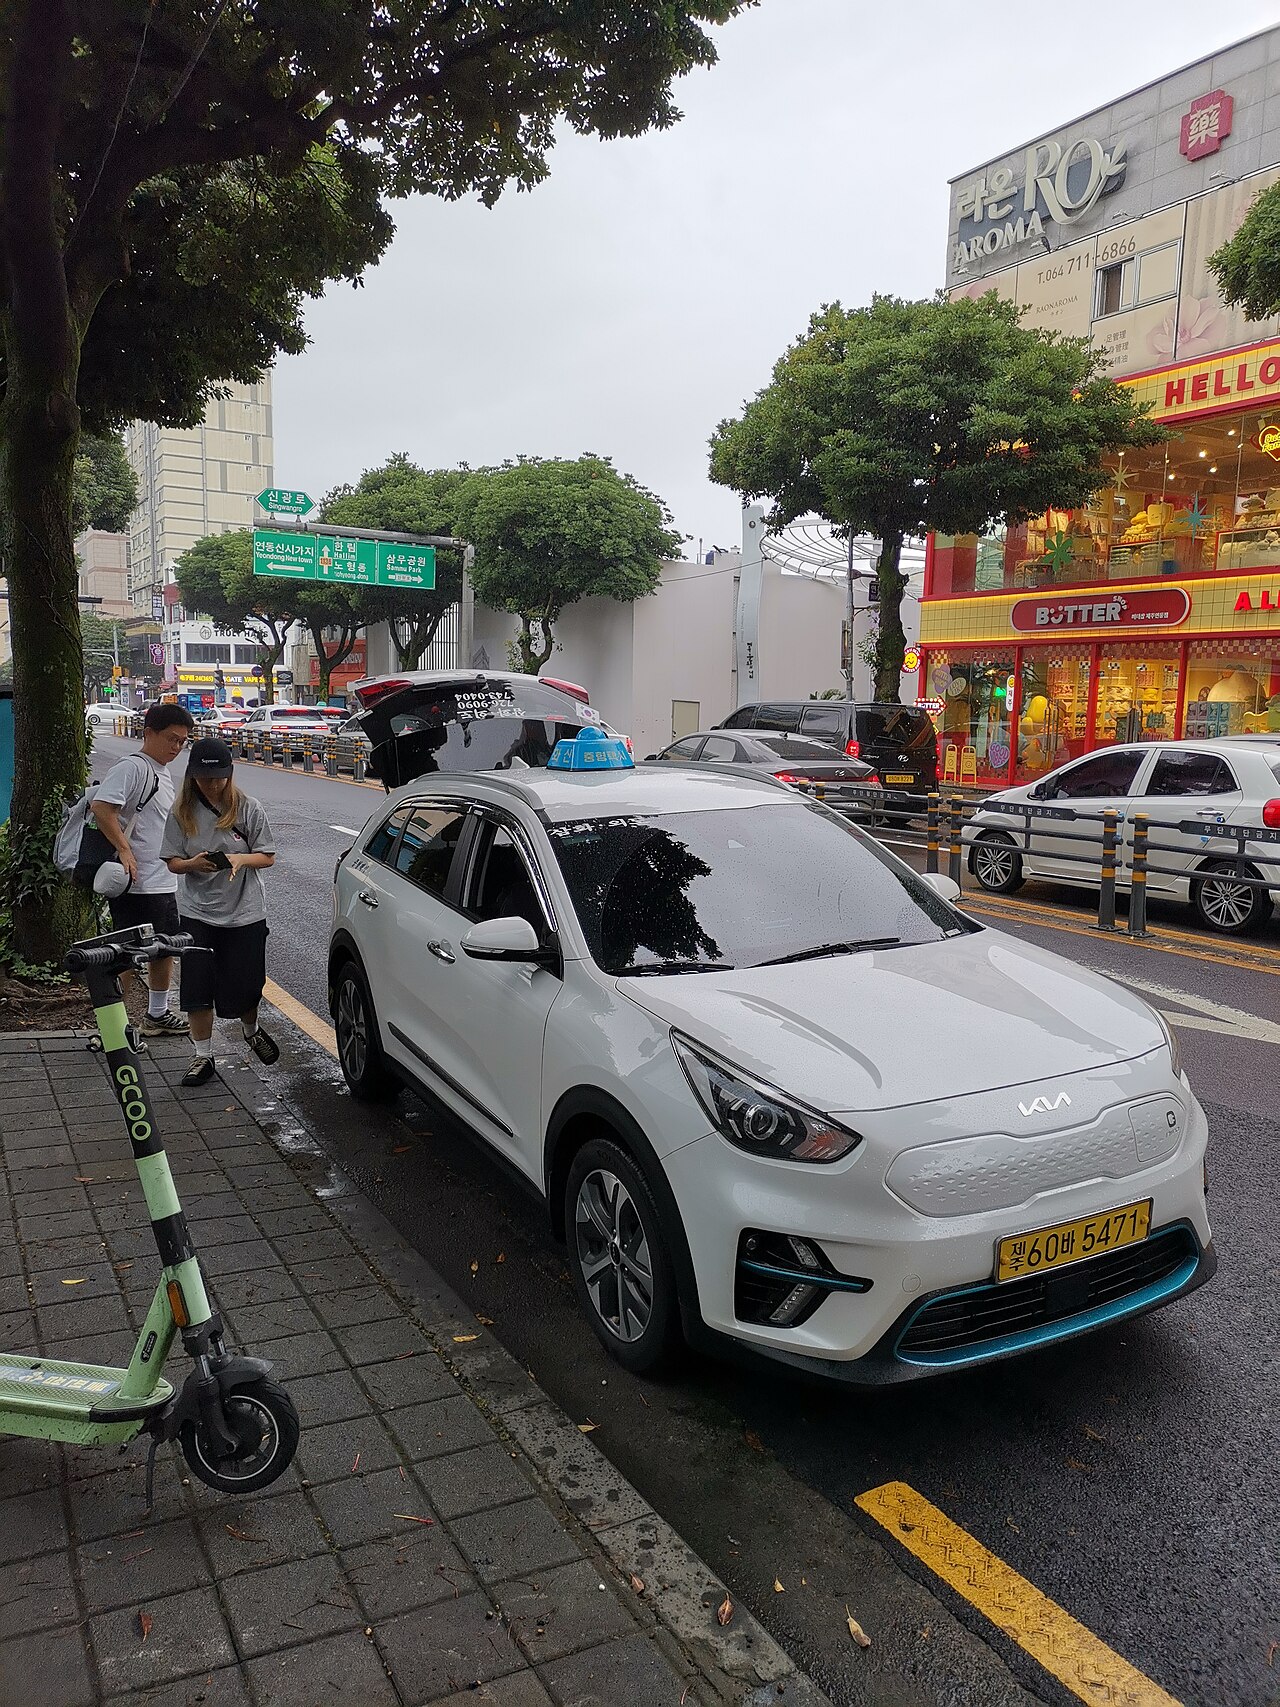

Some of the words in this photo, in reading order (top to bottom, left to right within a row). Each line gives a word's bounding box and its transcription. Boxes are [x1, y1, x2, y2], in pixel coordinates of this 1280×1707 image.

[1188, 101, 1221, 149] 藥
[956, 167, 1018, 223] 라온
[953, 210, 1046, 267] AROMA
[1037, 264, 1064, 284] T.064
[1067, 235, 1137, 275] 711-6866
[1165, 356, 1280, 408] HELLO
[267, 490, 306, 505] 신광로
[268, 503, 303, 513] Singwangro
[255, 541, 315, 557] 연동신시가지
[334, 541, 356, 553] 한림
[255, 552, 285, 562] Yeondong
[334, 552, 356, 560] Hallim
[387, 554, 426, 567] 삼우공원
[334, 561, 367, 573] 노형동
[387, 563, 408, 573] Sammu
[408, 565, 422, 574] Park
[1112, 595, 1128, 610] SHOP
[1234, 590, 1280, 612] AL
[244, 630, 268, 638] HAS
[116, 1065, 152, 1140] GCOO
[1082, 1209, 1137, 1252] 5471
